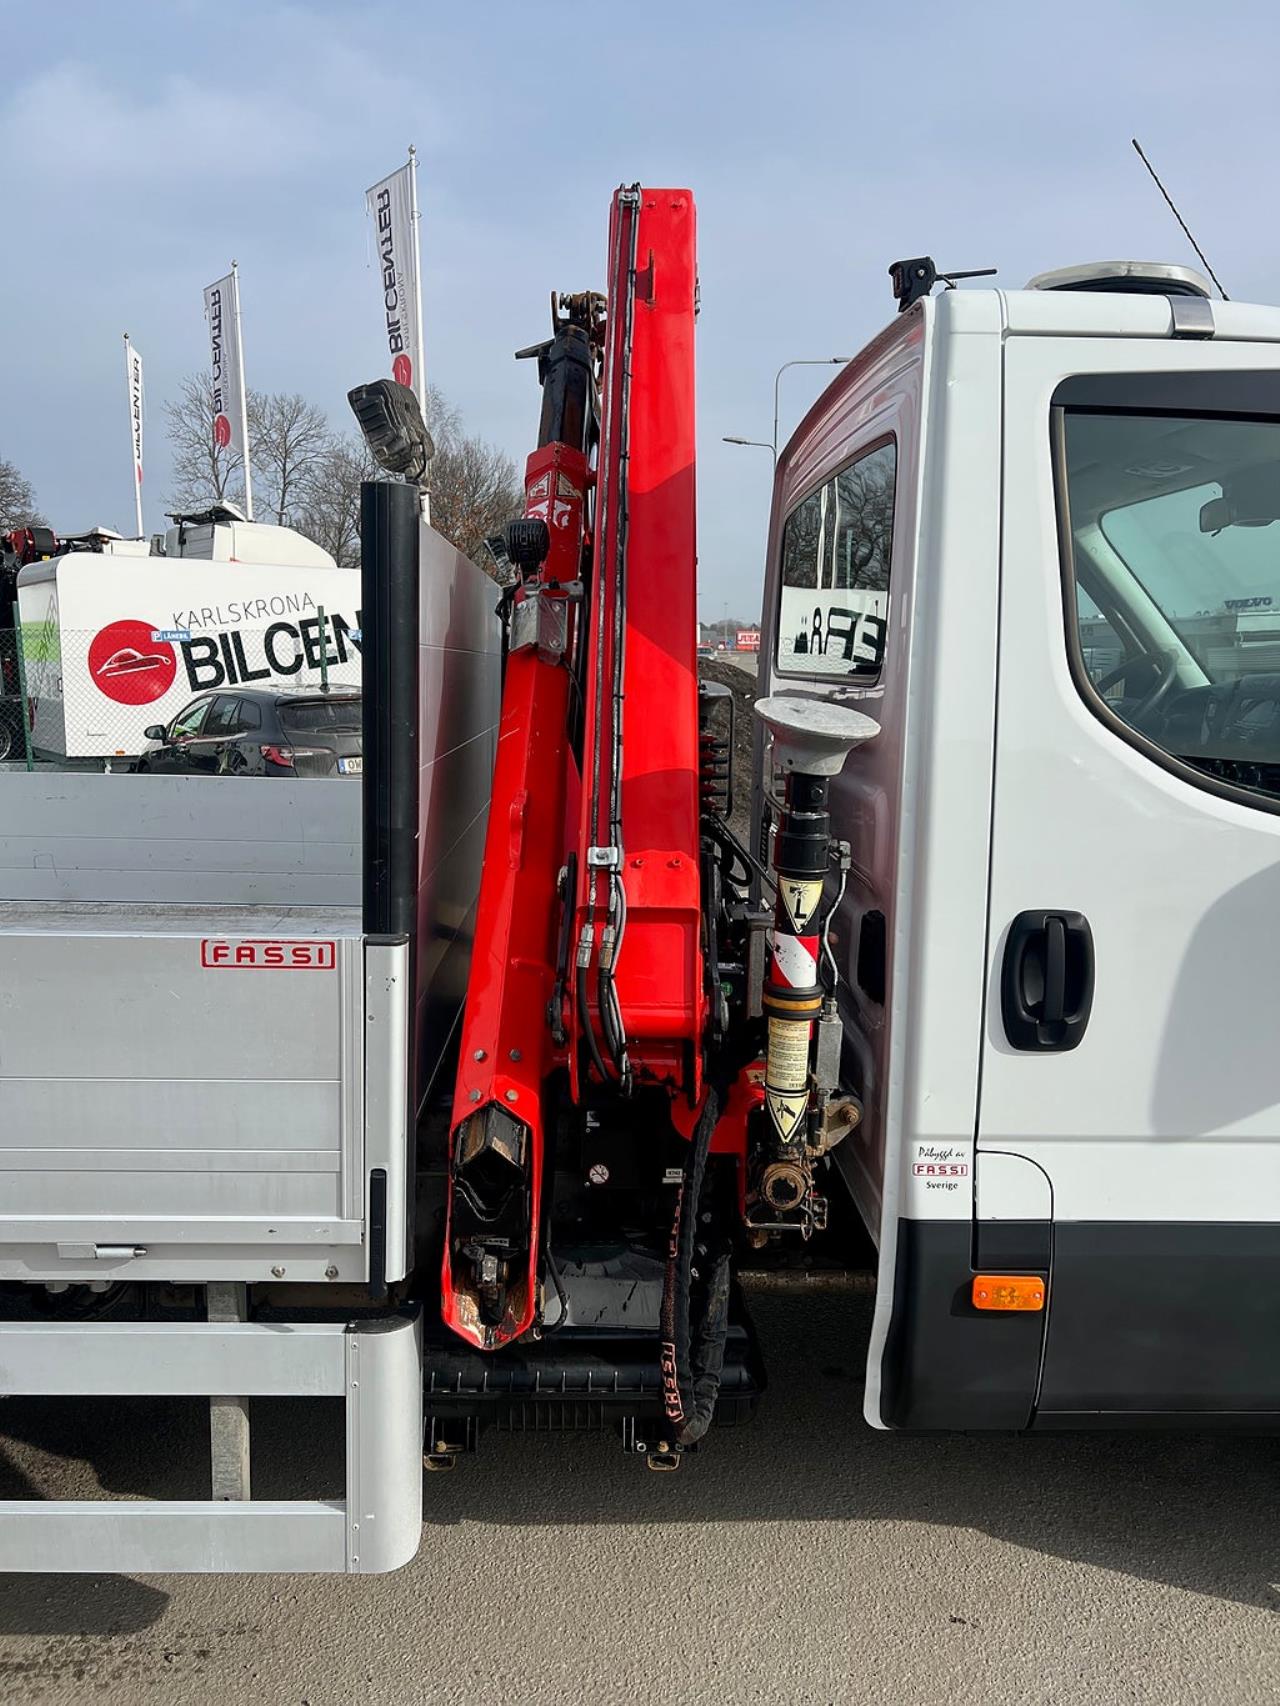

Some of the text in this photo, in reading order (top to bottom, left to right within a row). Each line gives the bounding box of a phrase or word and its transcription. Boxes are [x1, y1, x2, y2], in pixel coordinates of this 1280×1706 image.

[172, 592, 316, 629] KARLSKRONA
[212, 945, 324, 965] FASSI
[918, 1146, 953, 1161] Påbyggd
[916, 1165, 964, 1175] FASSI
[926, 1181, 958, 1191] Sverige
